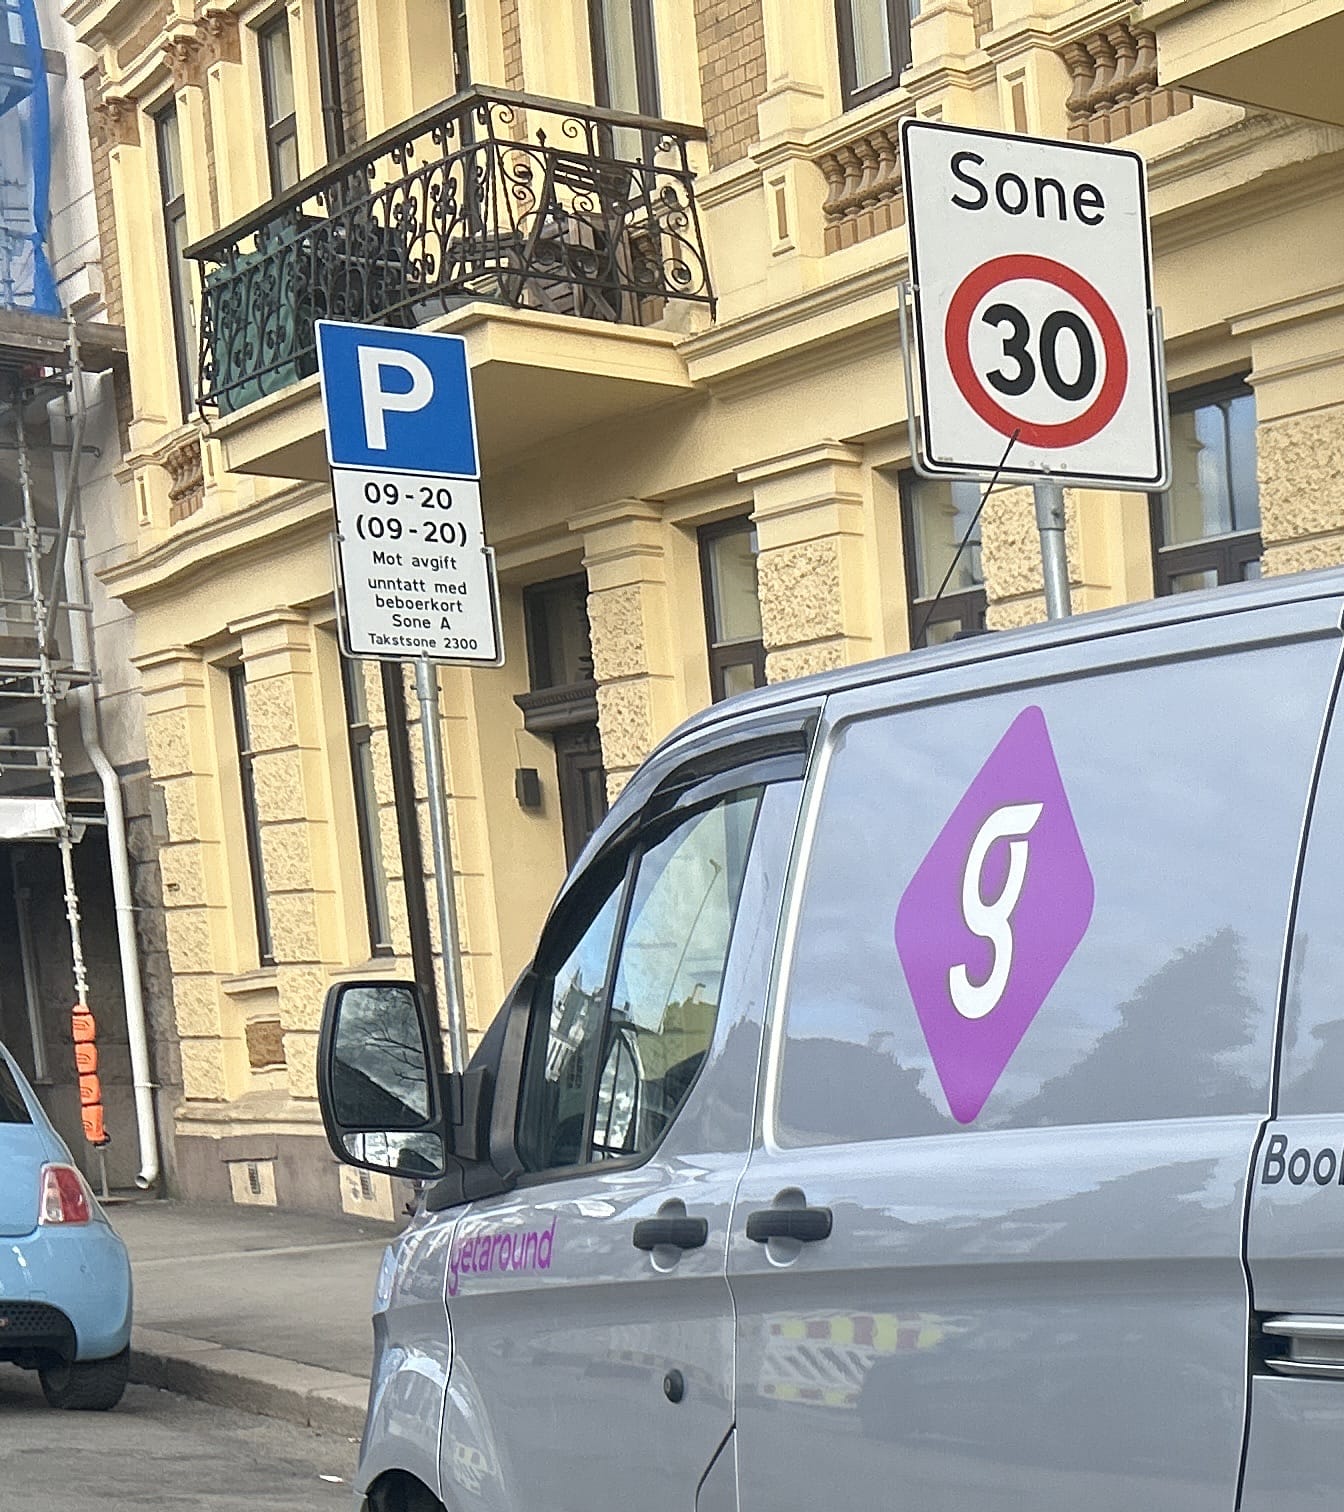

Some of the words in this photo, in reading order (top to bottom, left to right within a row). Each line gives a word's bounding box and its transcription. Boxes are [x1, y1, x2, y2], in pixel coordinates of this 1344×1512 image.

[950, 151, 1105, 226] Sone
[981, 303, 1097, 401] 30
[357, 345, 435, 451] P
[372, 550, 403, 567] Mot
[411, 555, 457, 572] avgift
[367, 576, 426, 593] unntatt
[434, 581, 467, 595] med
[375, 593, 464, 613] beboerkort
[392, 613, 431, 629] Sone
[440, 616, 451, 630] A
[367, 632, 437, 649] Takstsone
[443, 637, 478, 650] 2300
[448, 1214, 557, 1297] getaround
